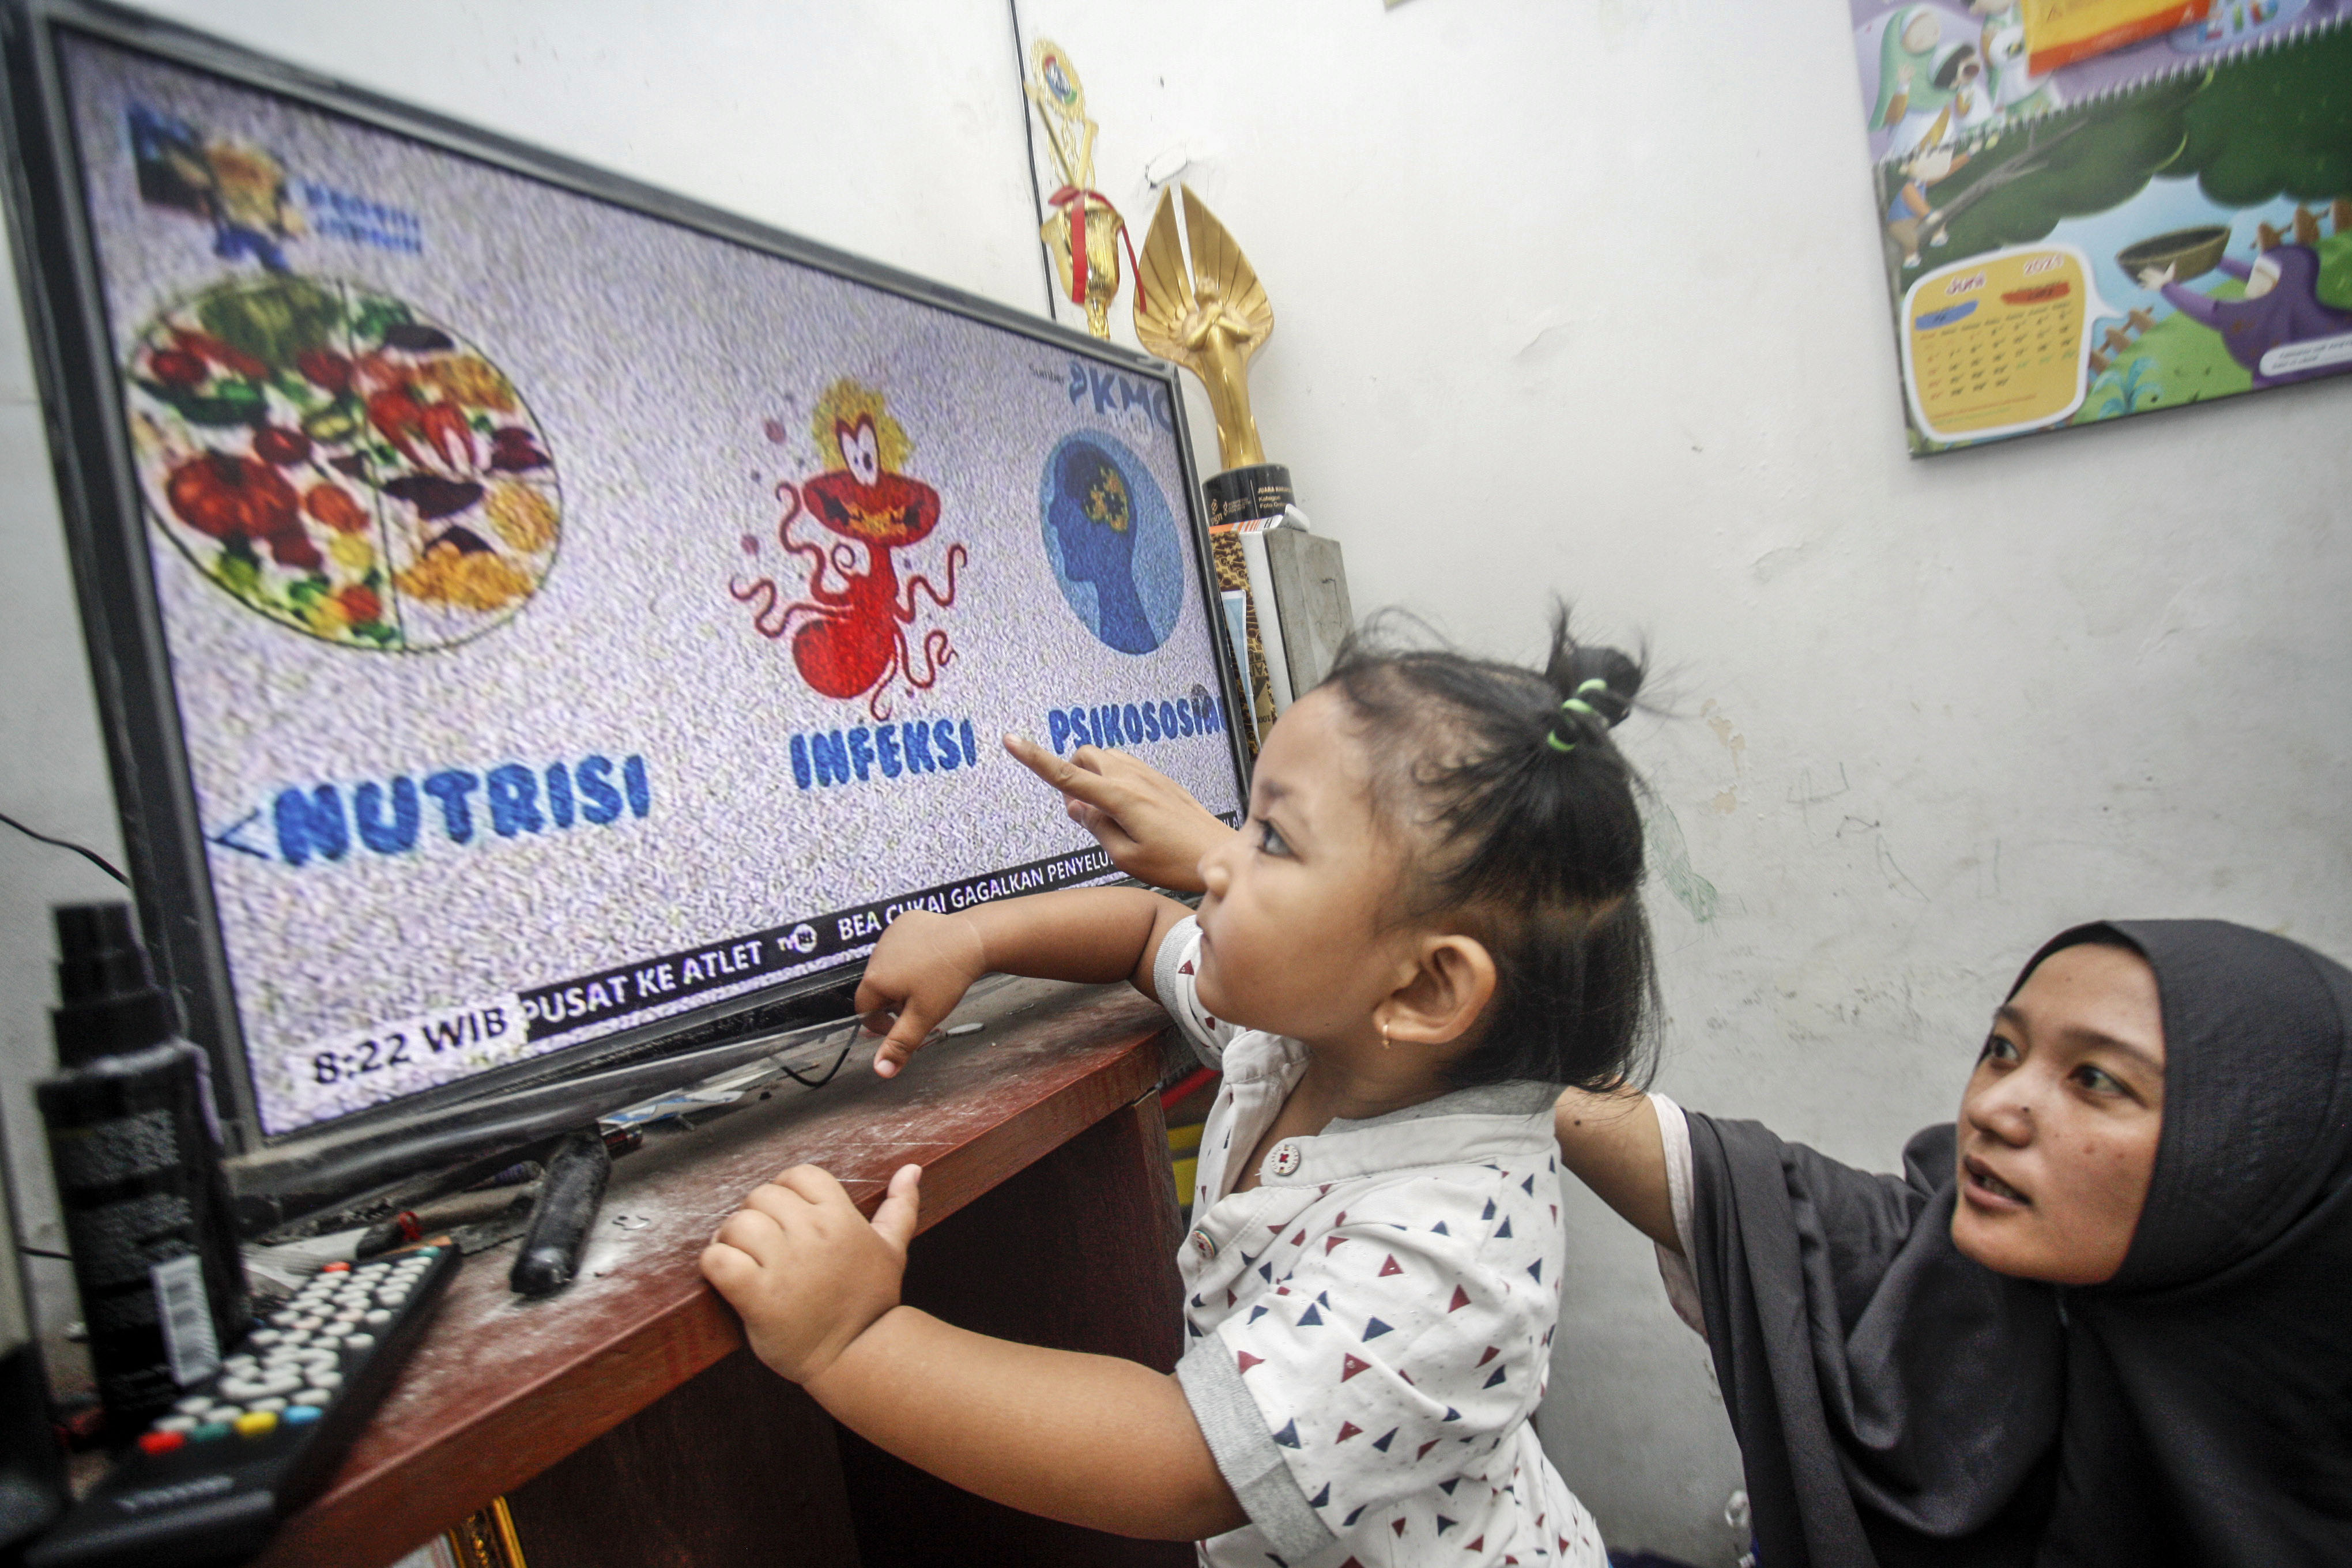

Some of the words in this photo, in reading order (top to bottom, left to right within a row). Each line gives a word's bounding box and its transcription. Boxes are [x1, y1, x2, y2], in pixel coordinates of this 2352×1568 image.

[791, 718, 975, 790] INFEKSI
[274, 754, 650, 866] NUTRISI
[522, 976, 628, 1022] PUSAT
[636, 964, 676, 997] KE
[684, 941, 762, 985] ATLET
[838, 911, 882, 940] BEA
[951, 868, 1044, 908] GAGALKAN
[1048, 851, 1114, 882] PENYELU
[314, 1034, 412, 1084] 8:22
[422, 1008, 507, 1053] WIB
